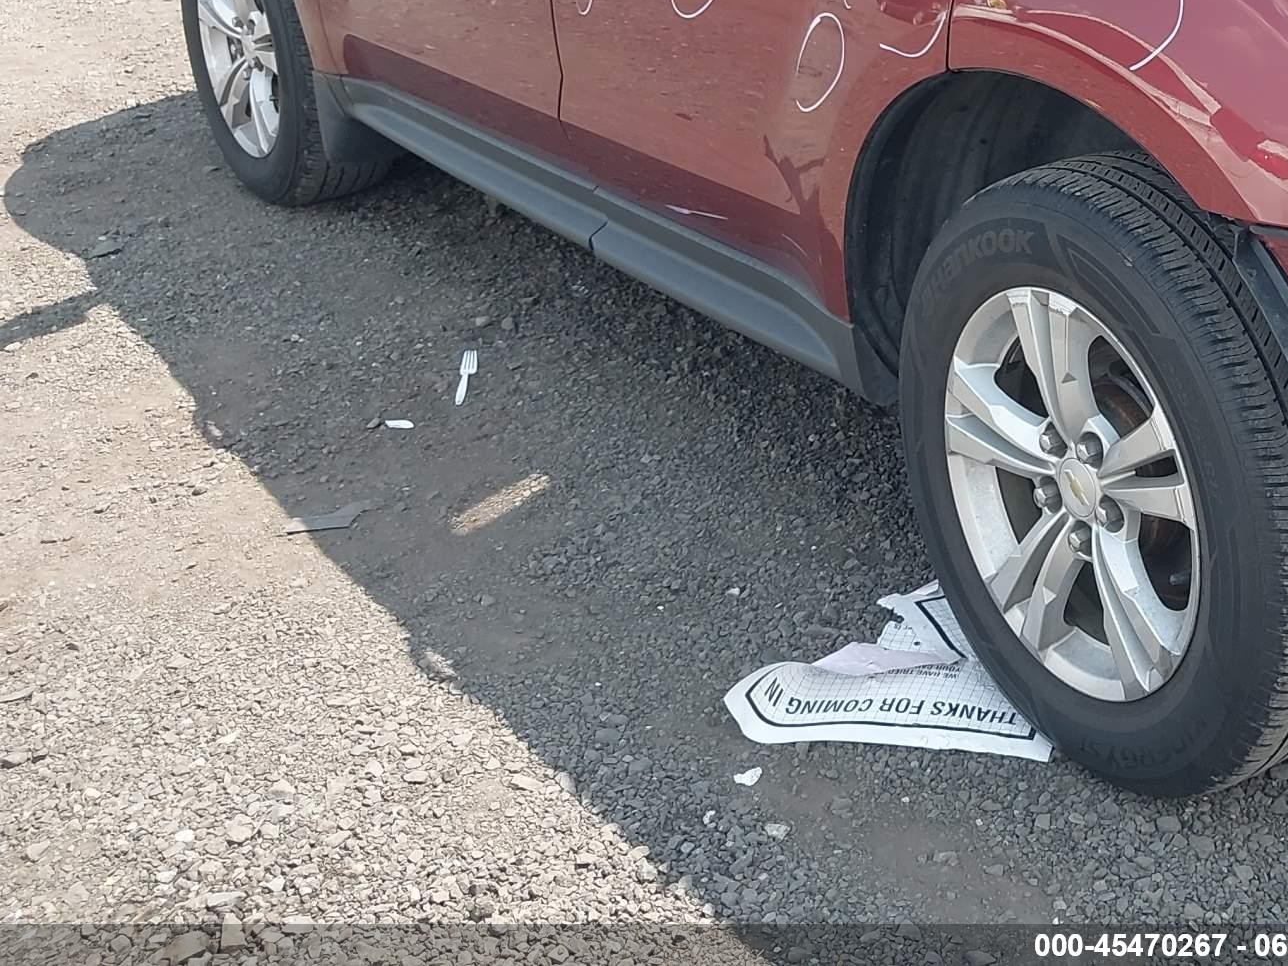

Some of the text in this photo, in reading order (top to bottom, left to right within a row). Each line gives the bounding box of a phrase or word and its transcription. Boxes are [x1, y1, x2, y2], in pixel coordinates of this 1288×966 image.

[763, 676, 1018, 727] THANKS FOR COMING IN
